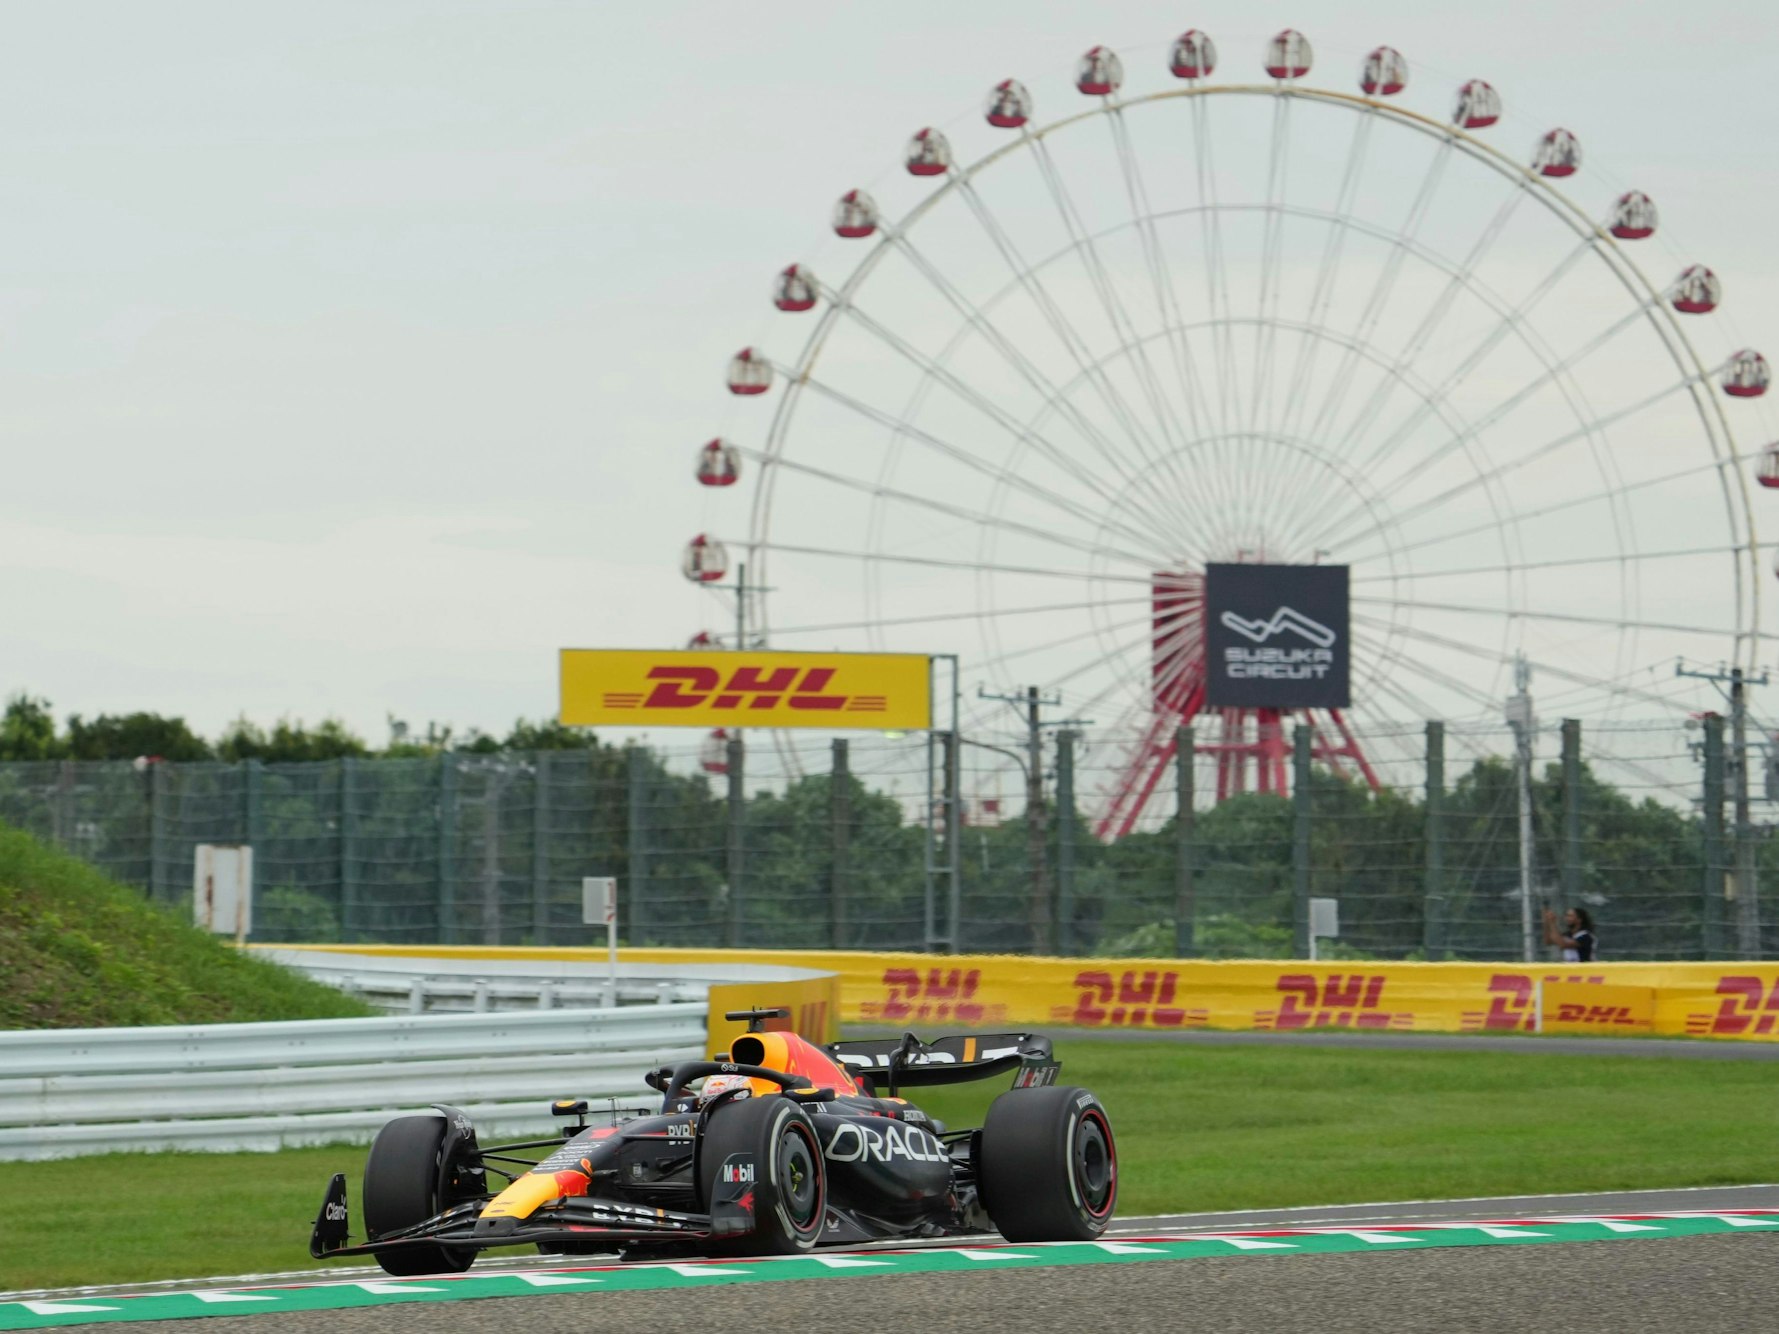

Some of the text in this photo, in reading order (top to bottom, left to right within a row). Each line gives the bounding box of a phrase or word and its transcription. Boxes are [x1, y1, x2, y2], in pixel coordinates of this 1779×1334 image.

[1224, 647, 1334, 663] SUZUKA
[1226, 663, 1330, 679] CIRCUIT
[642, 666, 849, 711] DHL
[880, 968, 984, 1024] DHL
[1073, 970, 1184, 1026] DHL
[1276, 973, 1392, 1030] DHL
[1556, 1004, 1634, 1025] DHL
[825, 1123, 950, 1163] ORACLE
[723, 1163, 755, 1183] Mobil
[326, 1202, 346, 1220] Claro
